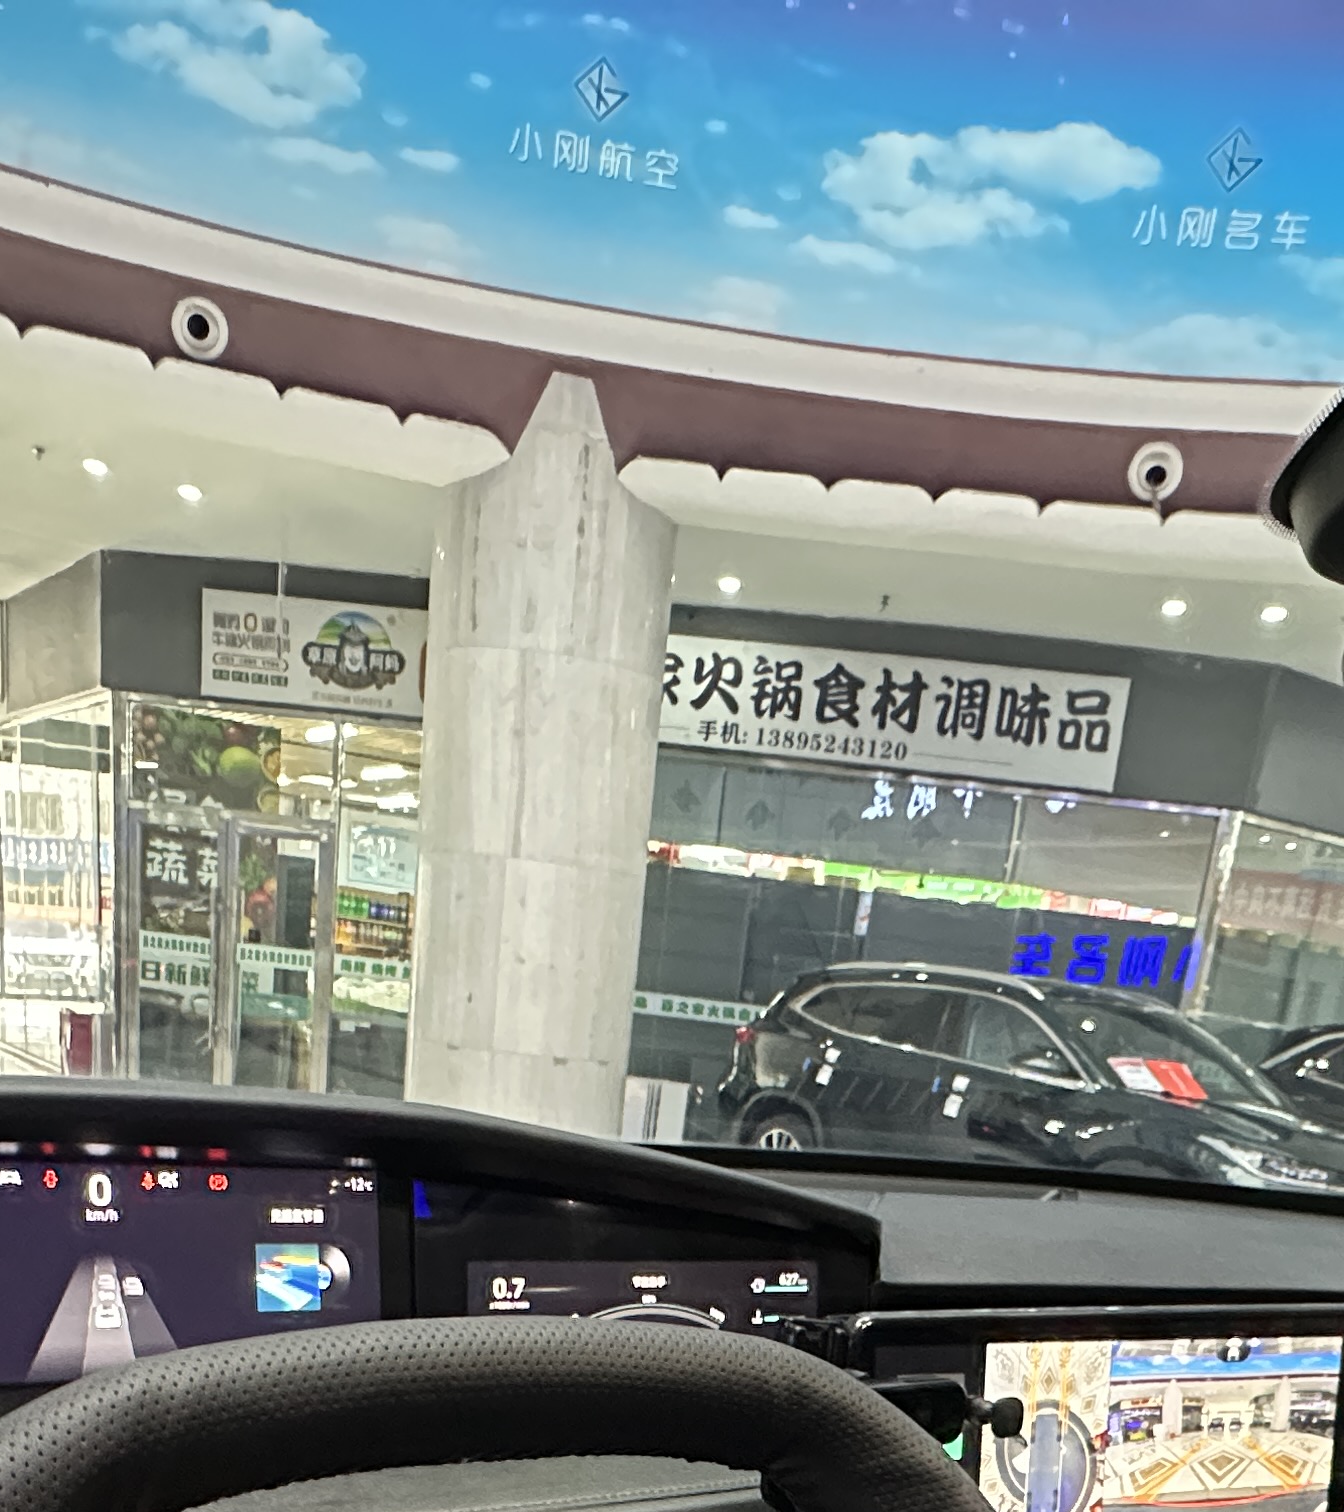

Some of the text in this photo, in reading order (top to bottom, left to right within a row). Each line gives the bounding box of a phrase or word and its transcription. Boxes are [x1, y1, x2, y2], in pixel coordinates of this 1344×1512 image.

[508, 122, 679, 190] 小刚航空
[1131, 203, 1312, 251] 小刚名车
[756, 727, 908, 762] 13895243120
[88, 1173, 112, 1207] 0
[85, 1208, 121, 1223] km/h
[492, 1276, 526, 1300] 0.7
